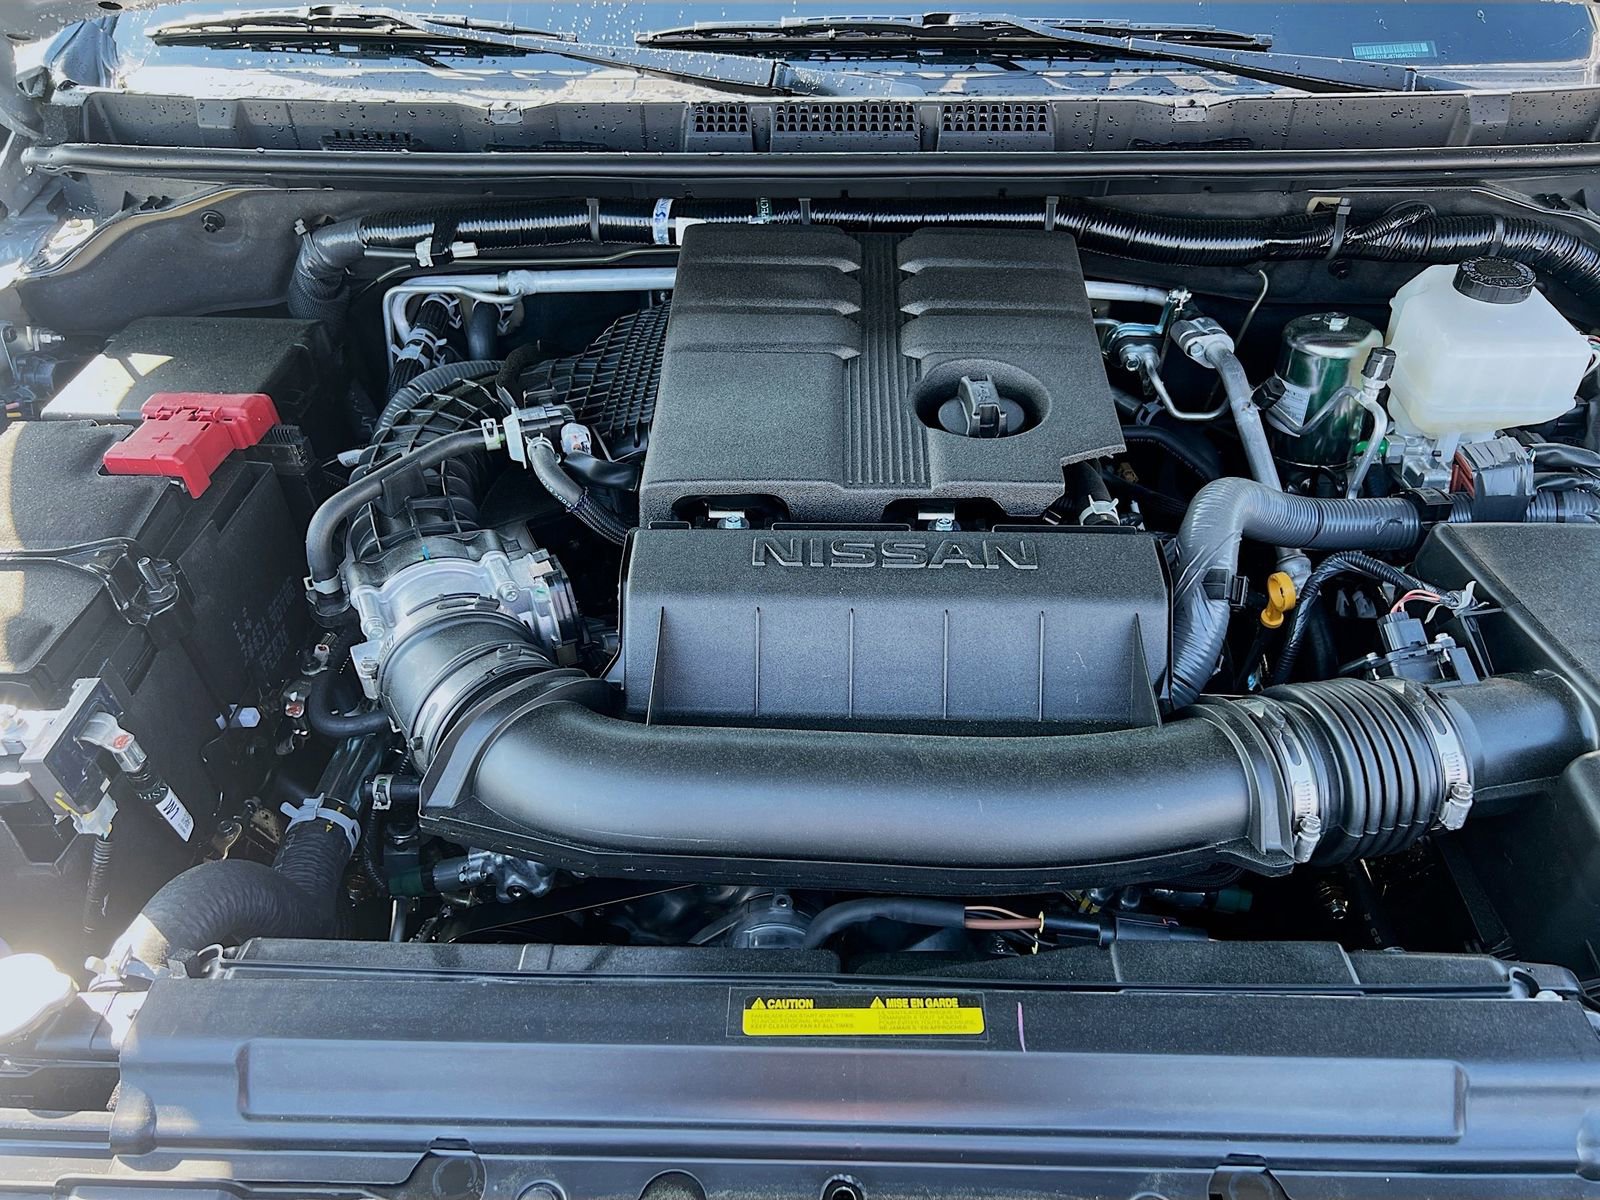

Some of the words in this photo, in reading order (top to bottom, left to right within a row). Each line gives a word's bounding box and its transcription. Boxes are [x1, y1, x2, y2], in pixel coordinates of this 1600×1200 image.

[752, 537, 1039, 570] NISSAN
[766, 998, 814, 1009] CAUTION
[885, 998, 909, 1008] MISE
[910, 998, 924, 1008] EN
[925, 997, 958, 1008] GARDE
